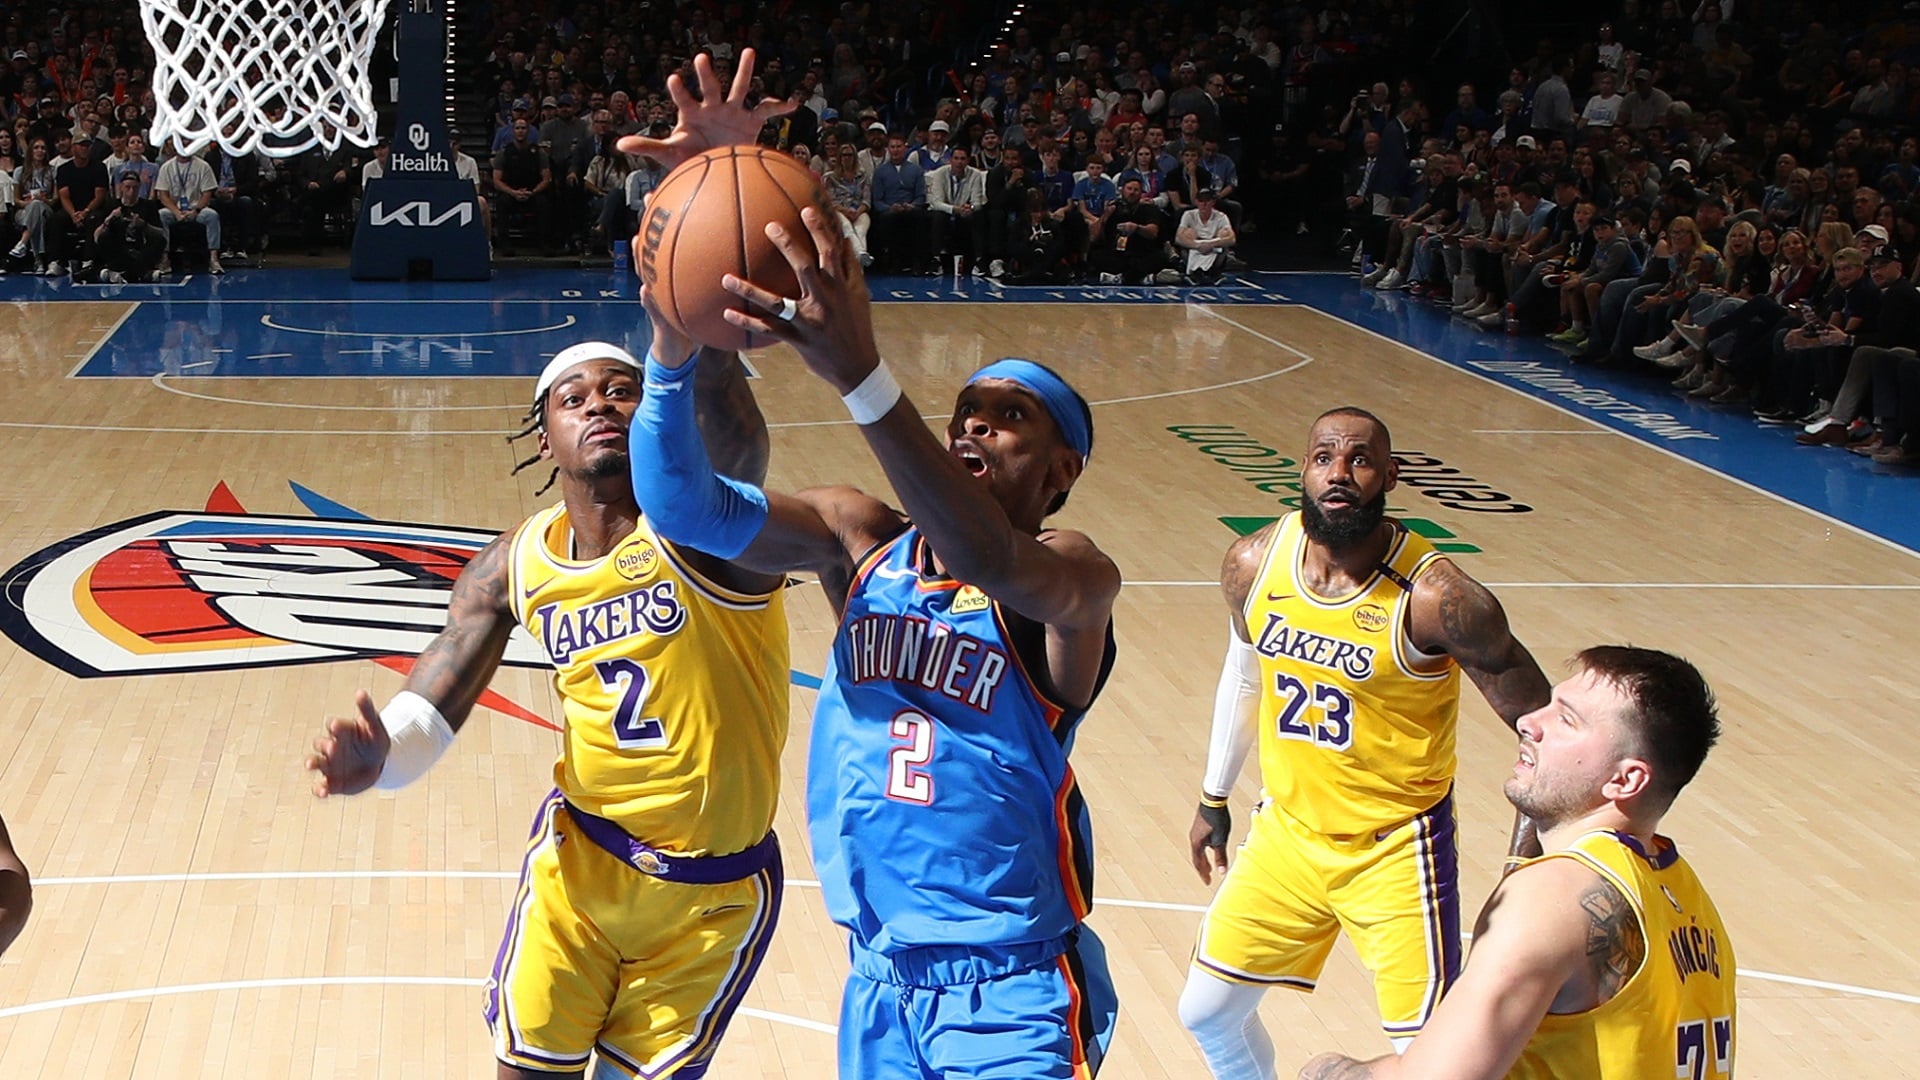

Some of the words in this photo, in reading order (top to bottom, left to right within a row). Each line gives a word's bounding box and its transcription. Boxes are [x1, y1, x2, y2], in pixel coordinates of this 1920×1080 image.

[408, 123, 430, 150] OU
[391, 152, 449, 172] Health
[370, 200, 473, 227] KIA
[890, 290, 1004, 299] CITY
[1607, 412, 1720, 440] BANK
[618, 549, 655, 569] bibigo
[536, 581, 687, 666] LAKERS
[1356, 610, 1387, 626] bibigo
[1255, 612, 1376, 682] LAKERS
[849, 615, 1008, 714] THUNDER
[593, 656, 667, 749] 2
[1274, 672, 1354, 752] 23
[885, 708, 935, 806] 2
